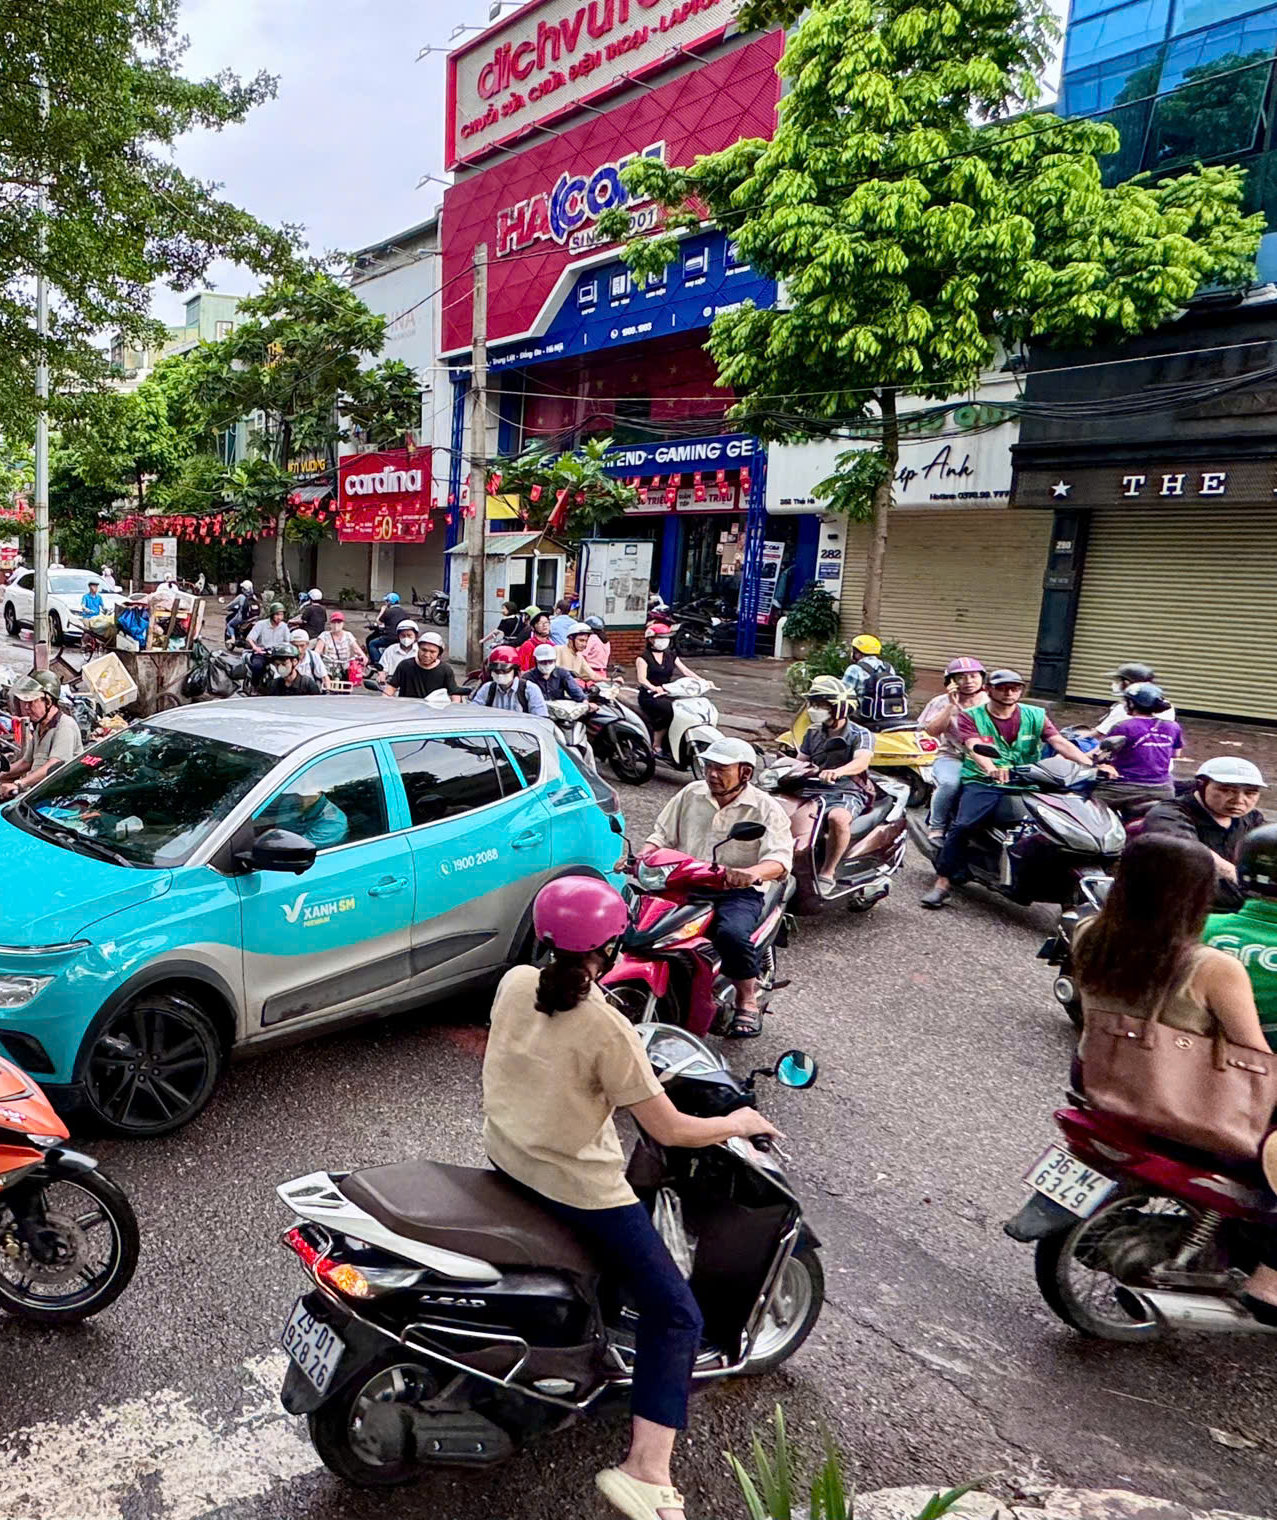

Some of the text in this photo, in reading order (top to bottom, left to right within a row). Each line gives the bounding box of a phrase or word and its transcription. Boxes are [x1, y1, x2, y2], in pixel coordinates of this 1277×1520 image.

[655, 442, 722, 463] GAMING
[726, 439, 755, 458] GE
[921, 444, 974, 480] Anh
[344, 465, 422, 496] cardina
[1122, 471, 1227, 497] THE
[821, 549, 842, 559] 282
[453, 847, 500, 872] 1900 2088
[303, 897, 356, 920] XANH SM
[1034, 1170, 1088, 1210] 6349
